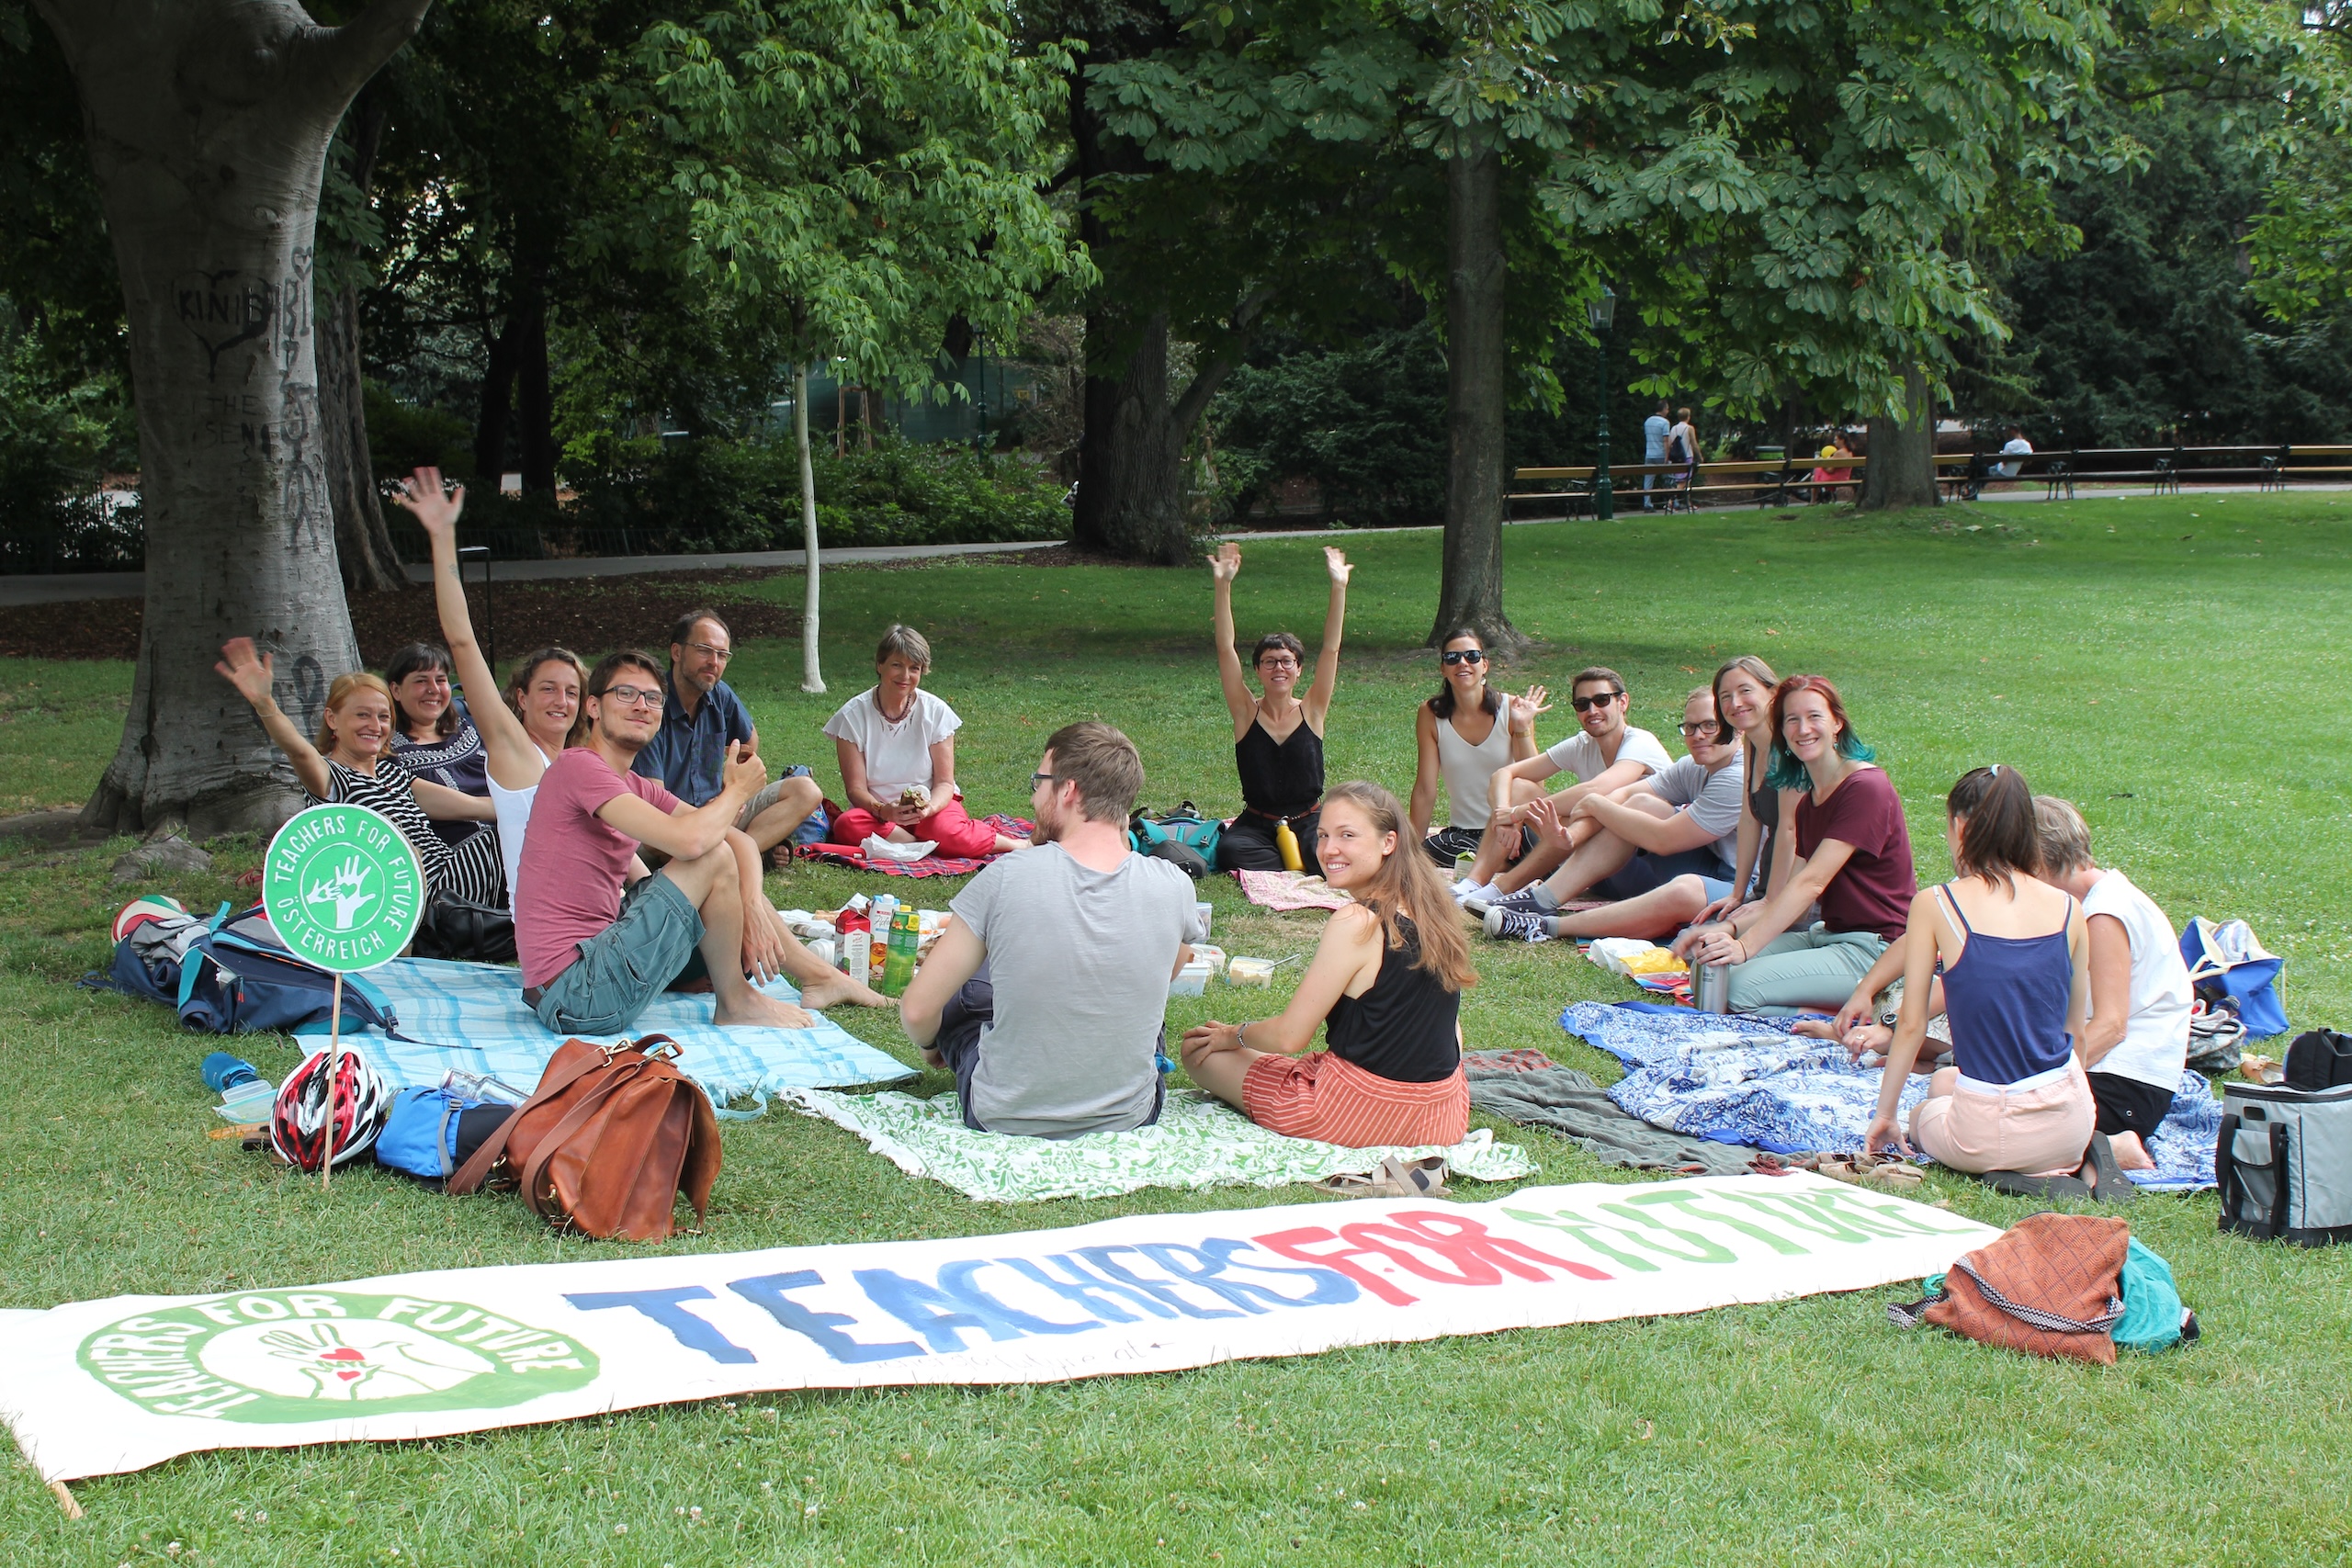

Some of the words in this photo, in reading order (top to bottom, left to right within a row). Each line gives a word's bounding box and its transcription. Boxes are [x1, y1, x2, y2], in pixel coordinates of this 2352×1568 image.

[274, 815, 346, 883] TEACHERS
[356, 819, 391, 853] FOR
[382, 855, 413, 932] FUTURE
[277, 895, 386, 960] ÖSTERREICH
[561, 1236, 1363, 1364] TEACHERS
[1250, 1211, 1615, 1307] FOR
[1499, 1187, 1989, 1272] FUTURE
[89, 1316, 262, 1419] TEACHERS
[189, 1293, 348, 1325] FOR
[376, 1296, 586, 1373] FUTURE
